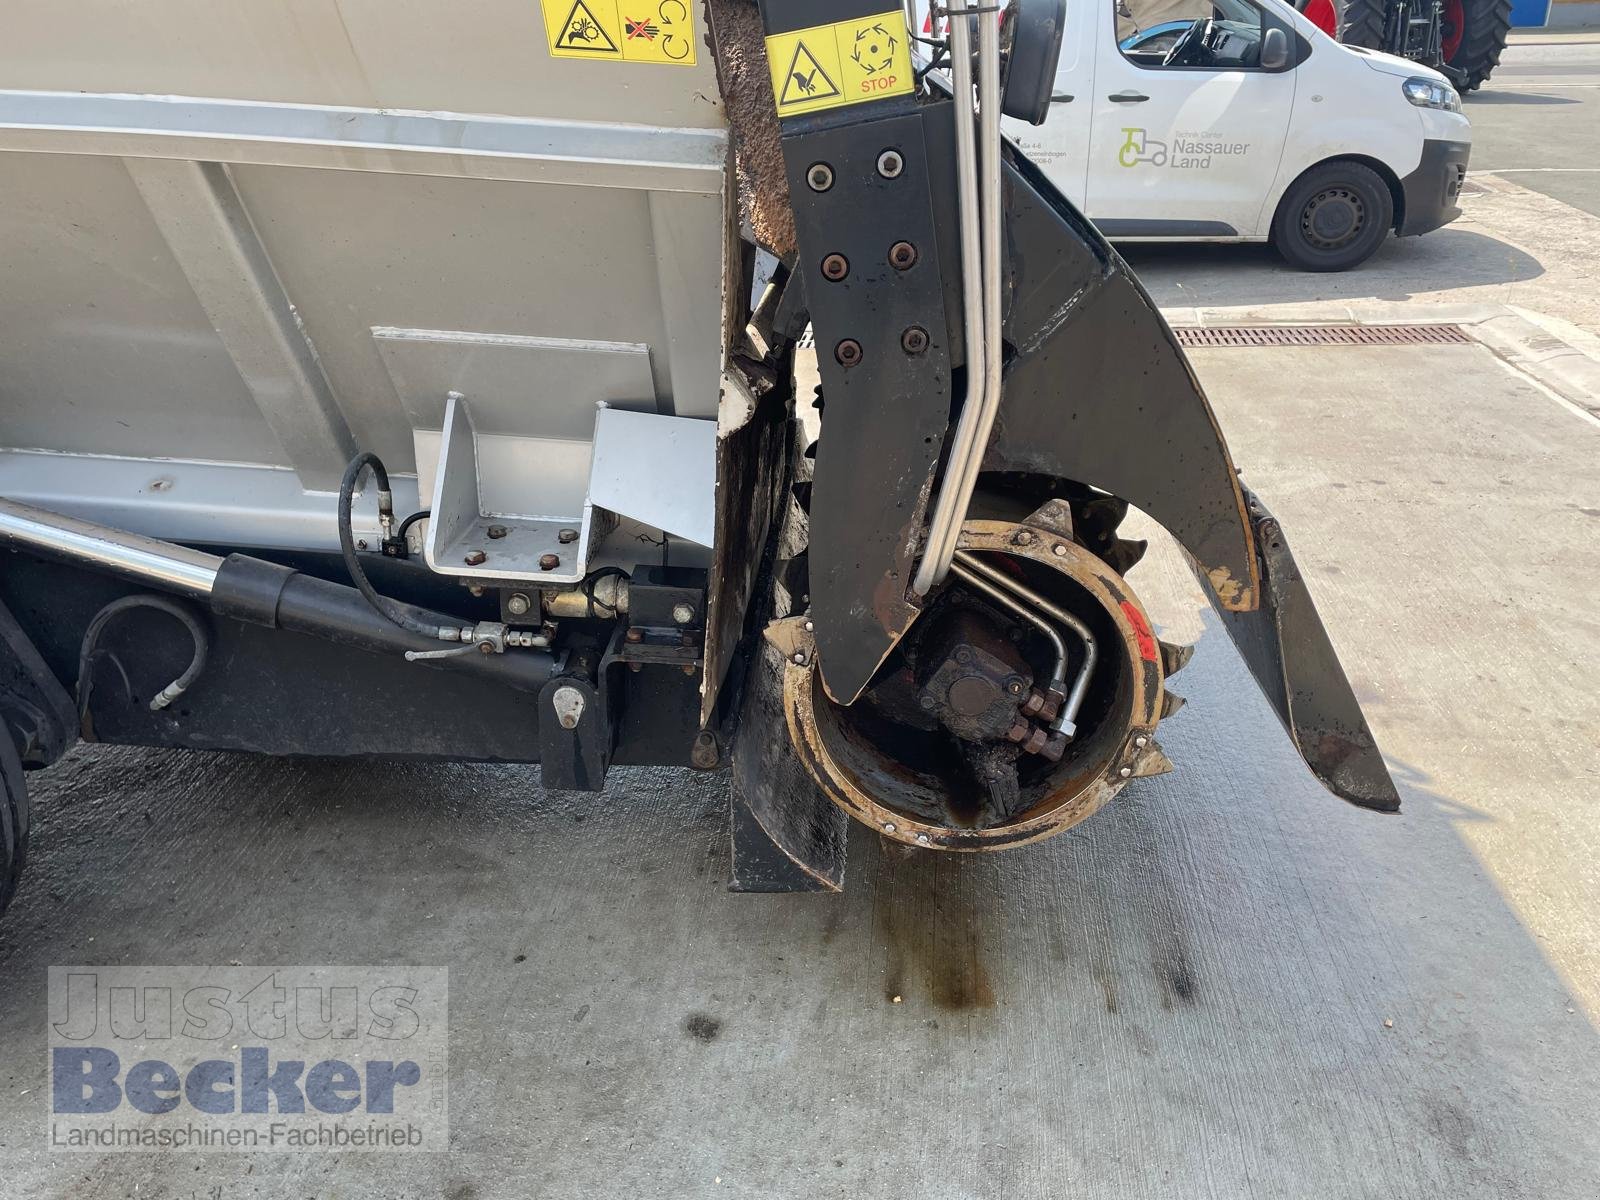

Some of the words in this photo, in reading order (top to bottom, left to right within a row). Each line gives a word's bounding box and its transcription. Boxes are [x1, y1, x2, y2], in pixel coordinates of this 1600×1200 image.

[861, 75, 897, 93] STOP
[1173, 139, 1250, 155] Nassauer
[1170, 155, 1211, 168] Land
